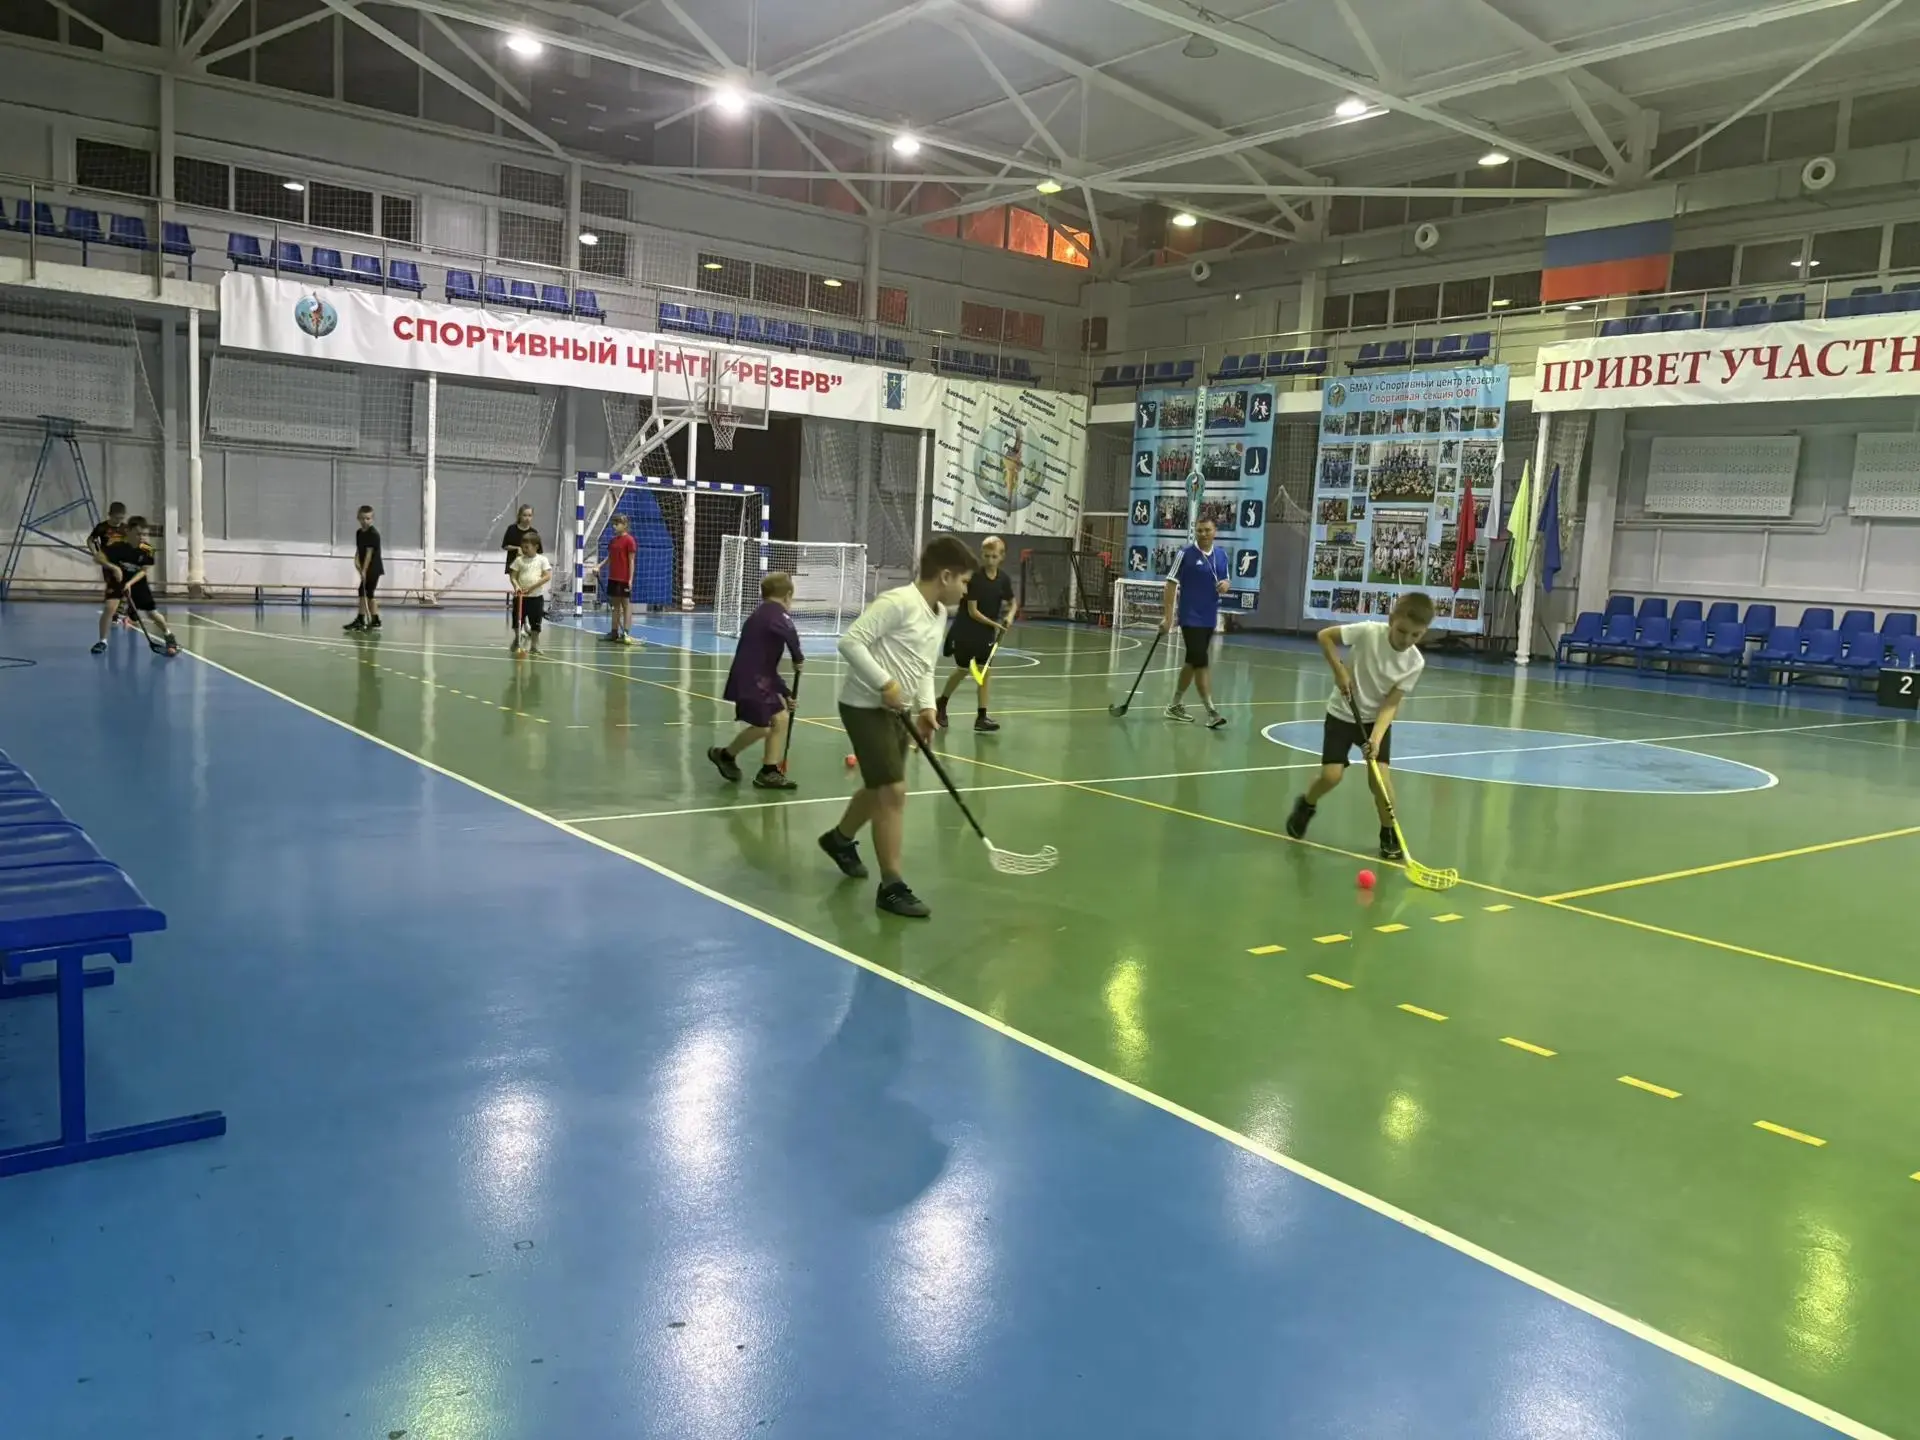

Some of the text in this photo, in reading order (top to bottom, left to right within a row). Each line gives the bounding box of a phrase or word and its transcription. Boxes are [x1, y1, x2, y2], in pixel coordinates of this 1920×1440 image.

[393, 315, 618, 366] СПОРТИВНЫЙ
[626, 346, 714, 379] ЦЕНТР
[1540, 335, 1920, 393] ПРИВЕТ УЧАСТН
[1436, 377, 1463, 389] центр
[1423, 390, 1454, 400] секция
[1456, 387, 1478, 399] ОФП
[1899, 675, 1914, 695] 2
